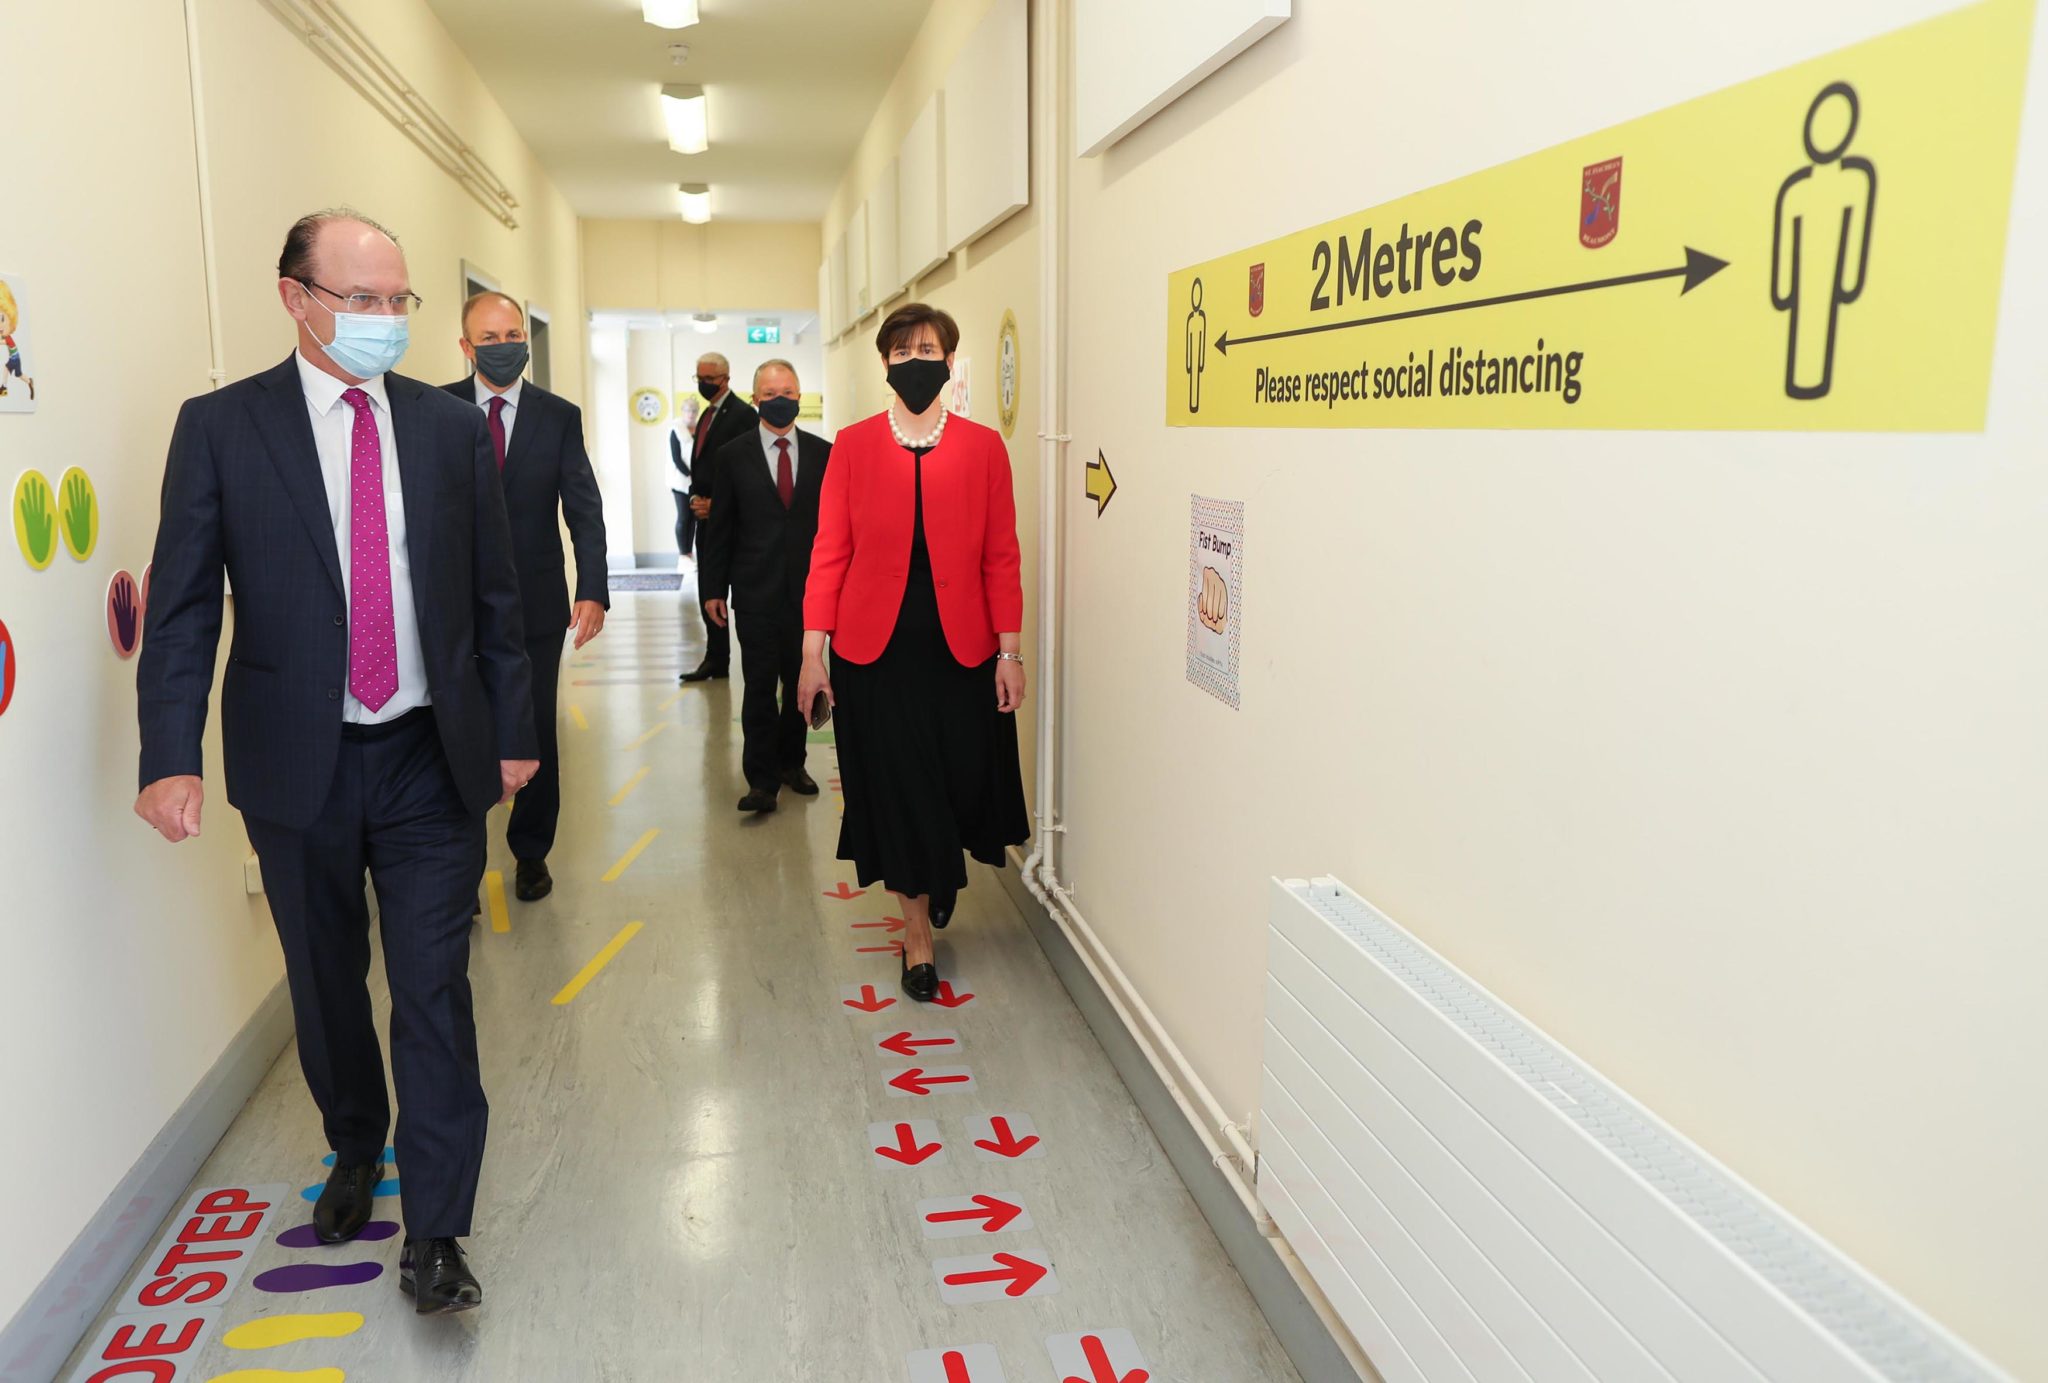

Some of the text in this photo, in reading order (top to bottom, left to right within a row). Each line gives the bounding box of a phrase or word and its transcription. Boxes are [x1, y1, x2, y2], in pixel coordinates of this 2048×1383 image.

[1309, 219, 1483, 312] 2 Metres
[1255, 337, 1584, 410] Please respect social distancing
[1198, 530, 1232, 560] Fist Bump
[138, 1189, 271, 1306] STEP
